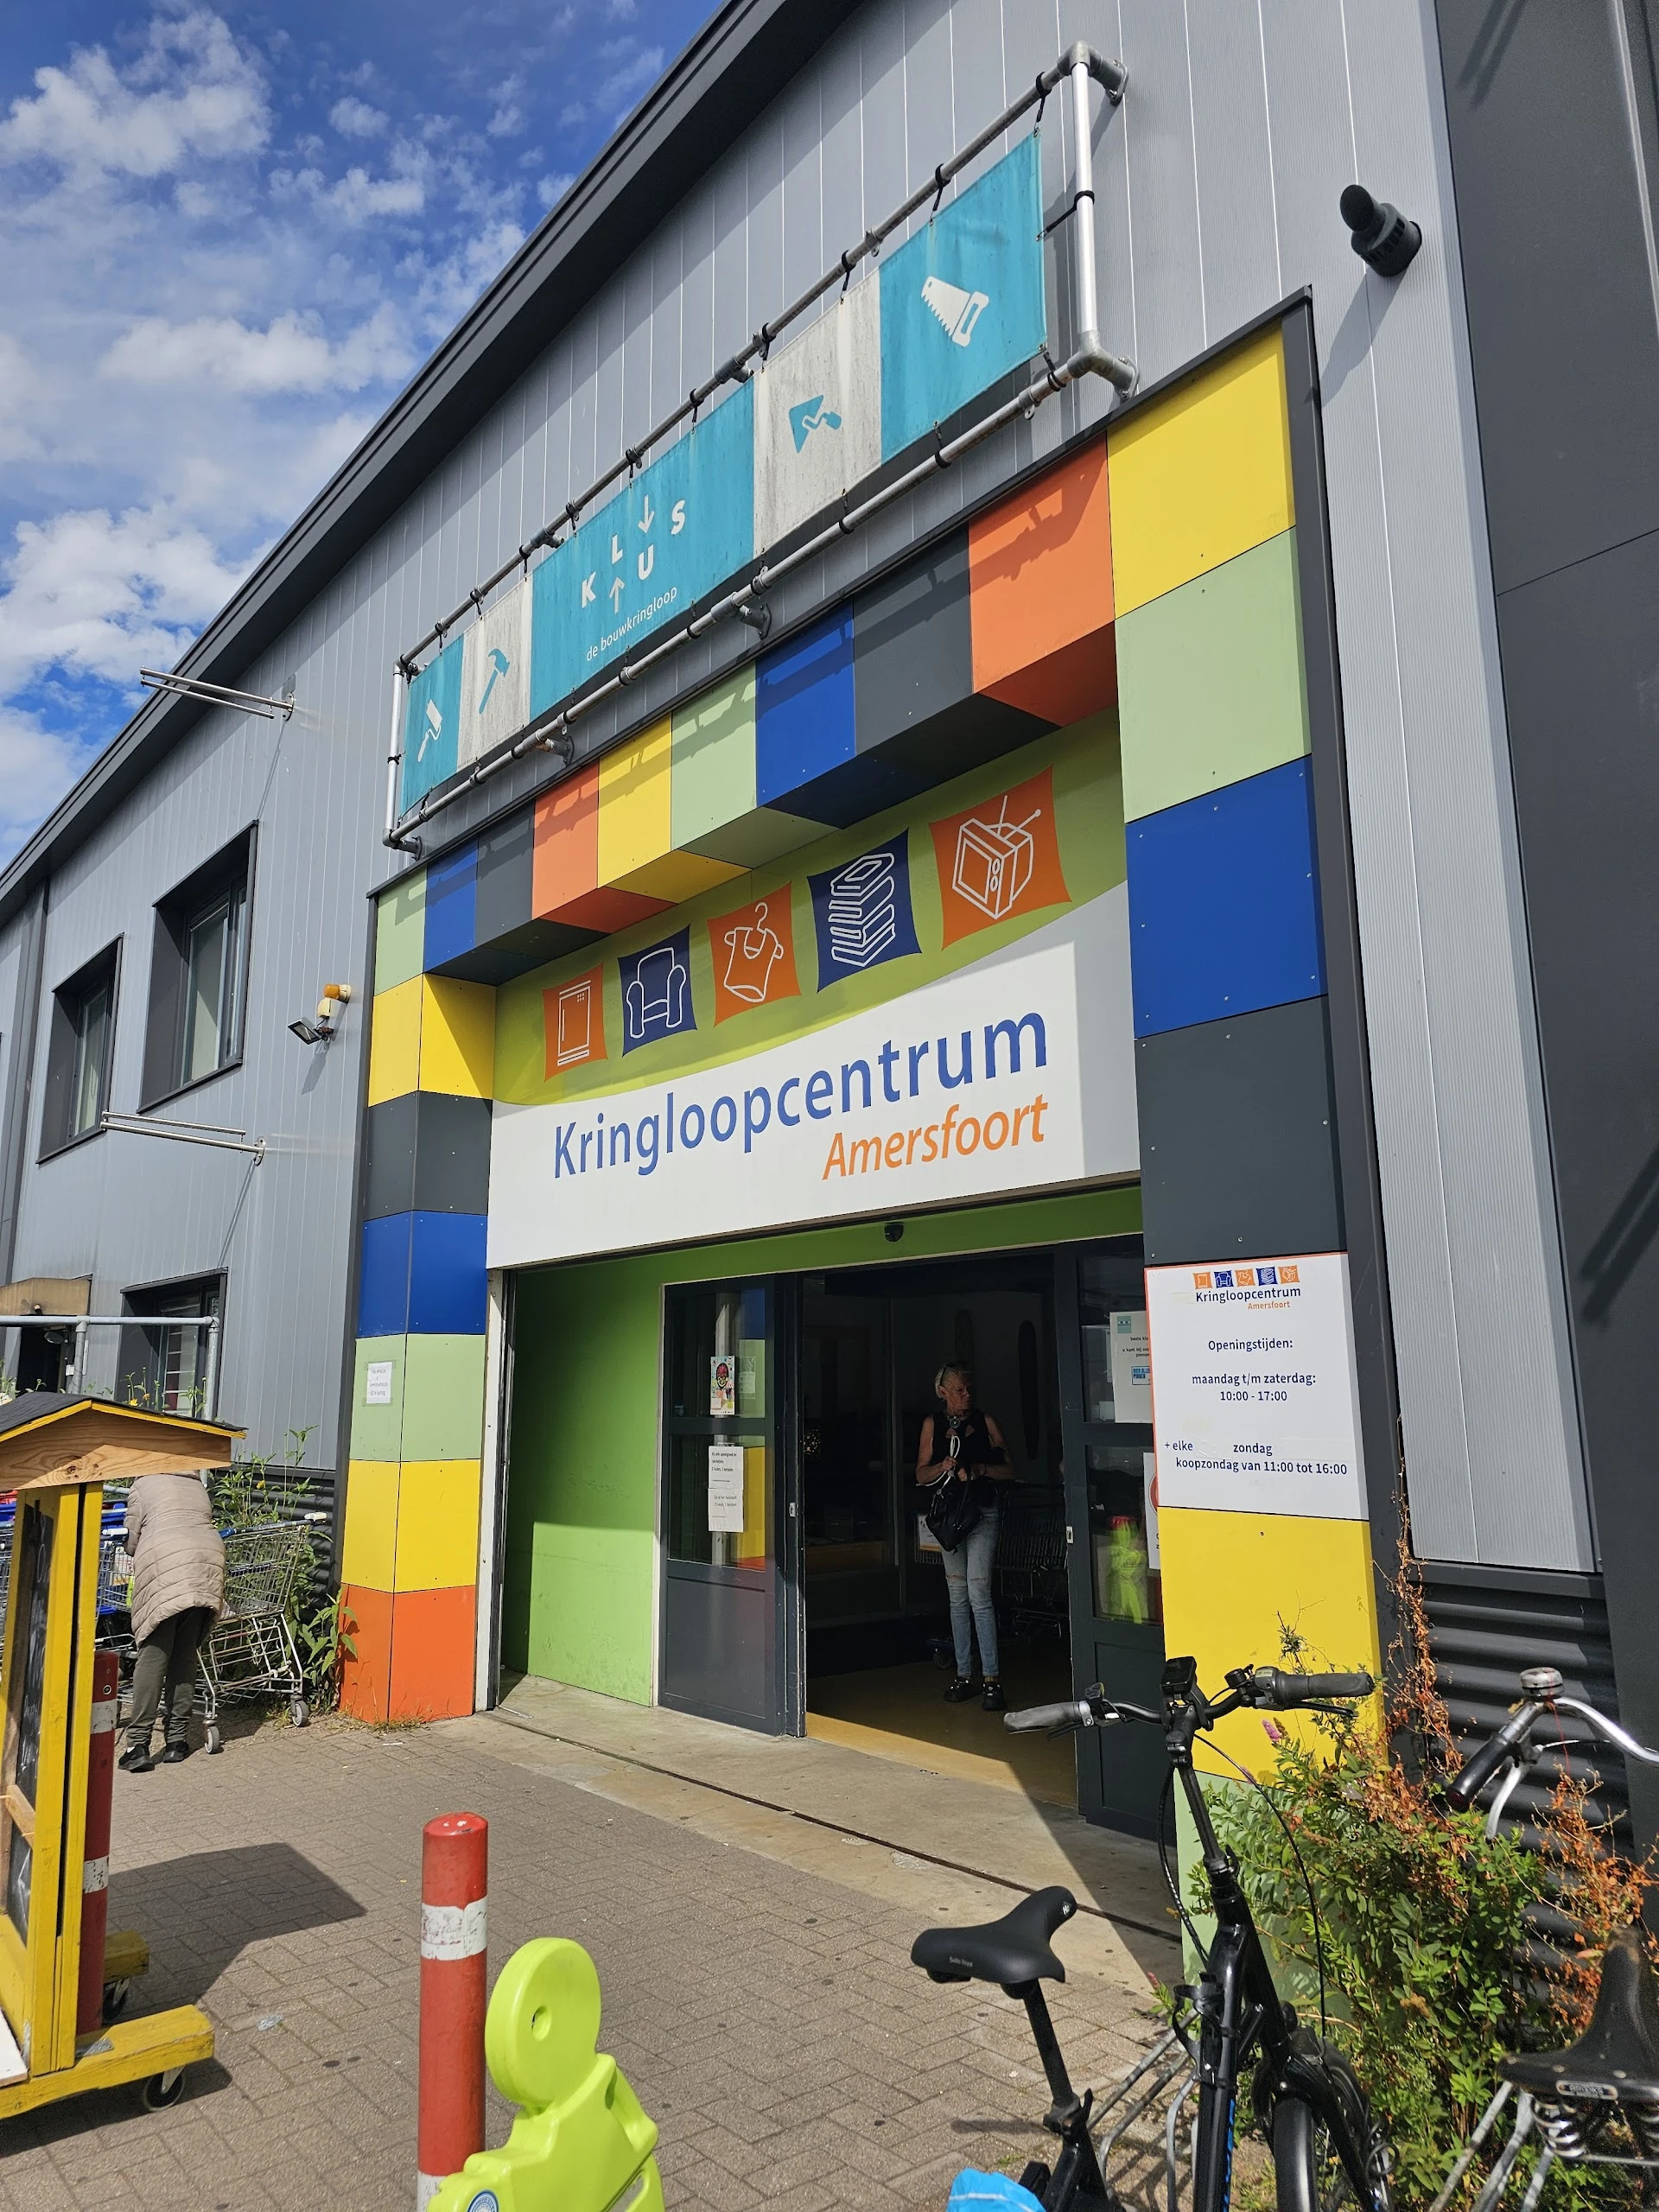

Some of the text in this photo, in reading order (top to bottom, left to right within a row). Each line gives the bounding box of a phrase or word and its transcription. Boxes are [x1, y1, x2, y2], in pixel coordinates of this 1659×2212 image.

[587, 587, 677, 662] de bouwkringloop
[554, 1012, 1048, 1179] Kringloopcentrum
[822, 1093, 1049, 1180] Amersfoort
[1196, 1287, 1301, 1304] Kringloopcentrum
[1248, 1300, 1291, 1310] Amersfoort
[1208, 1338, 1294, 1352] Openingstijden:
[1192, 1372, 1316, 1387] maandag t/m zaterdag:
[1220, 1390, 1249, 1402] 10:00
[1258, 1390, 1287, 1402] 17:00
[1173, 1440, 1193, 1451] elke
[1233, 1442, 1273, 1457] zondag
[1176, 1457, 1347, 1475] koopzondag van 11:00 tot 16:00
